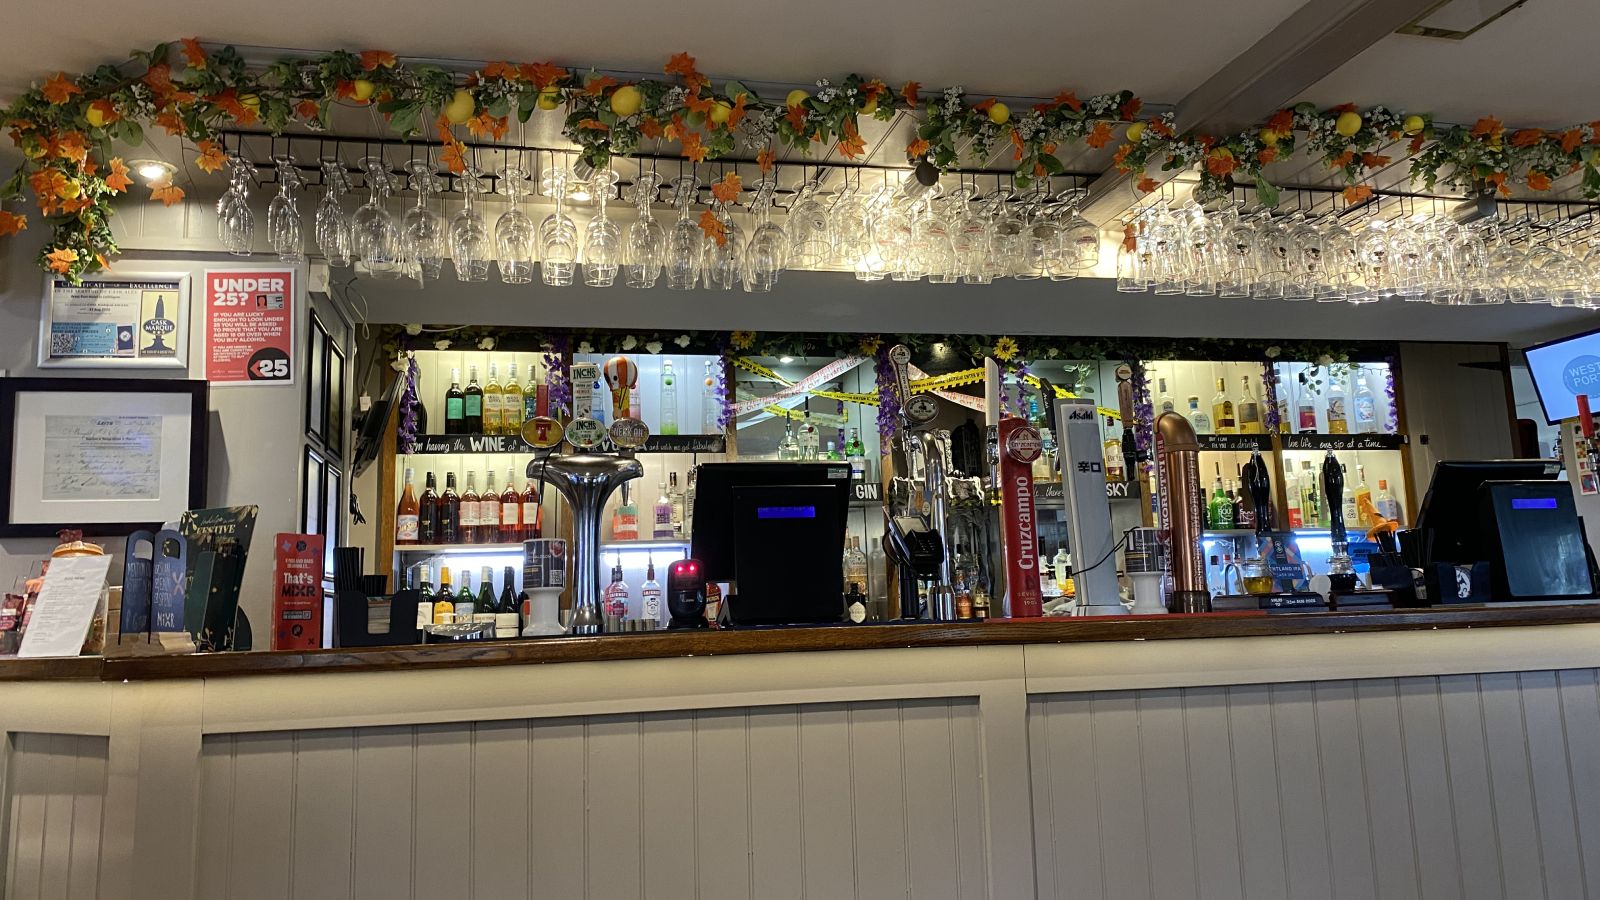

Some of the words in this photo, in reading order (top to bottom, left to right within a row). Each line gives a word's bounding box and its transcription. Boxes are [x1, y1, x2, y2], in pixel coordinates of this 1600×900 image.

[213, 278, 284, 292] UNDER
[213, 292, 249, 306] 25?
[1069, 411, 1094, 420] Asahi
[426, 438, 450, 453] having
[453, 439, 466, 450] the
[470, 436, 505, 452] WINE
[507, 440, 517, 451] of
[1333, 439, 1344, 449] sip
[1346, 438, 1354, 448] at
[1077, 461, 1102, 473] 辛口
[856, 484, 878, 500] GIN
[1158, 460, 1170, 531] MORETTI
[1016, 476, 1033, 570] Cruzcampo
[1163, 537, 1173, 587] BIRRA
[283, 572, 314, 585] That's
